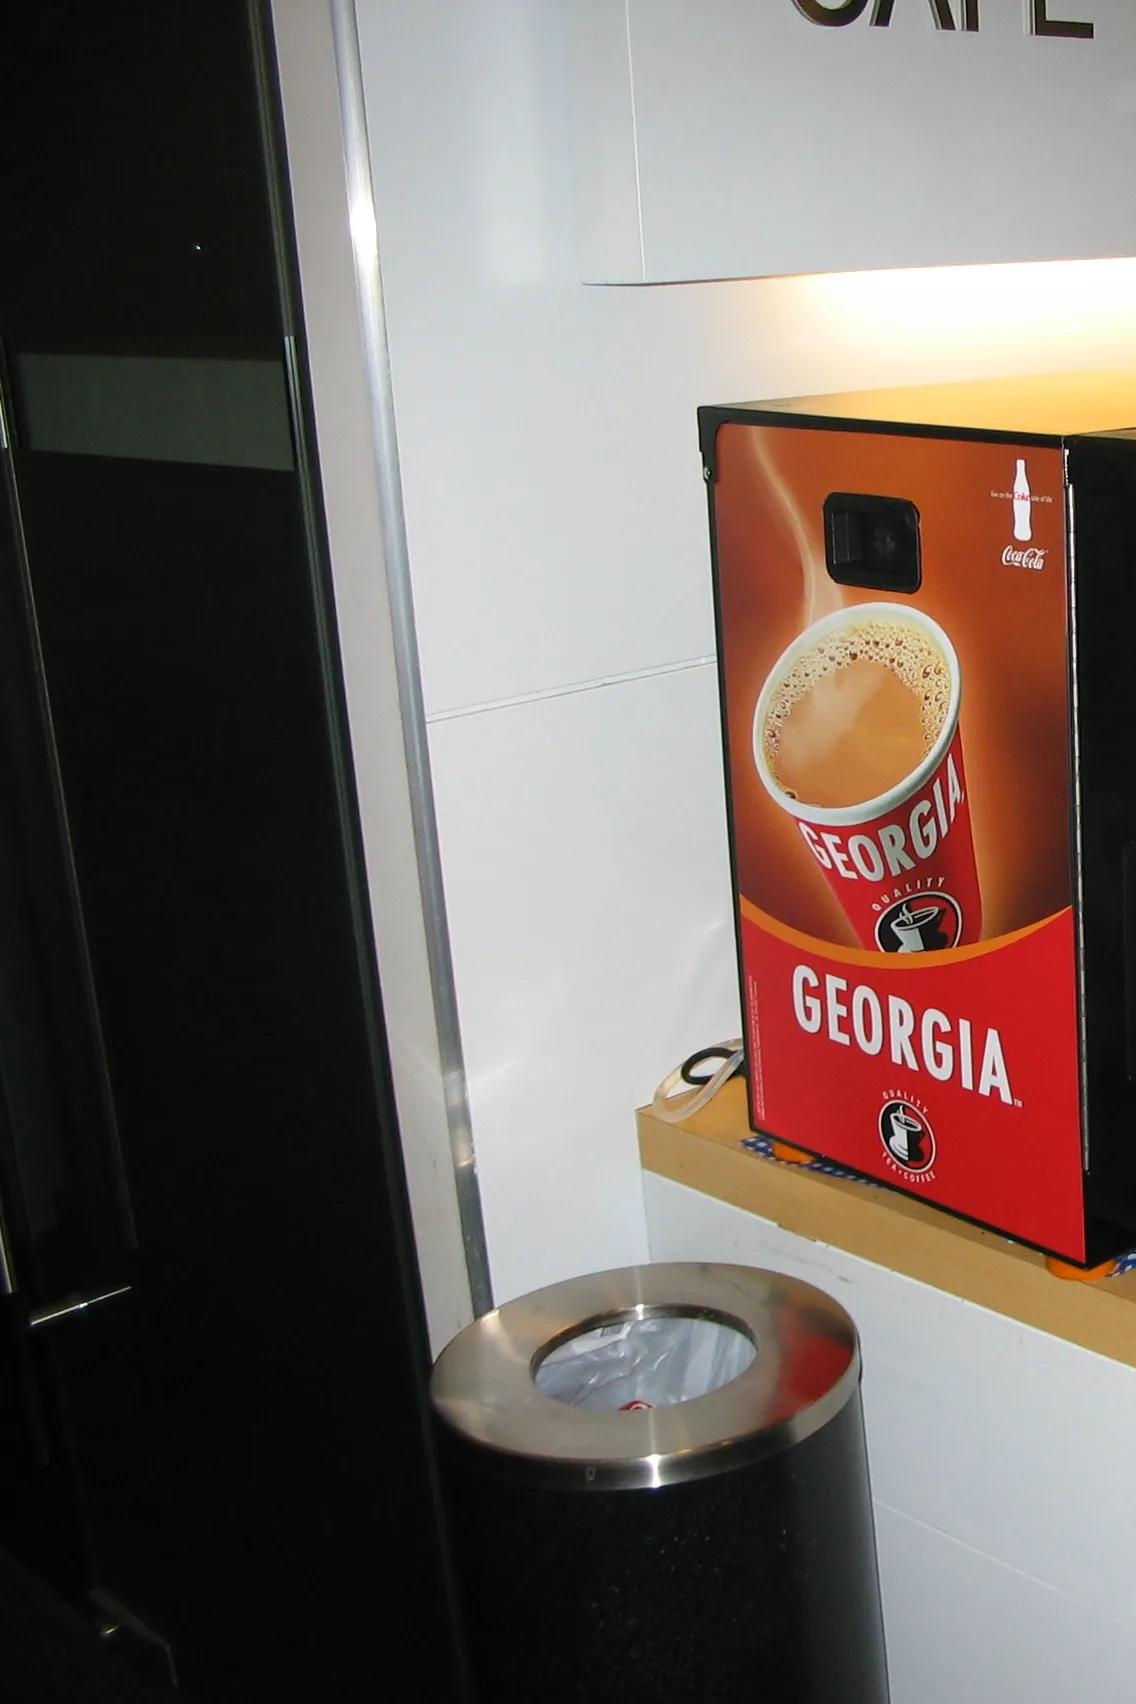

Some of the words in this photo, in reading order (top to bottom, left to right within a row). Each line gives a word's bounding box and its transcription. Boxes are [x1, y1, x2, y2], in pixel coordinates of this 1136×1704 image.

[798, 752, 963, 882] GEORGIA
[871, 876, 946, 912] QUALITY
[791, 964, 1013, 1106] GEORGIA
[881, 1089, 929, 1114] QUALITY
